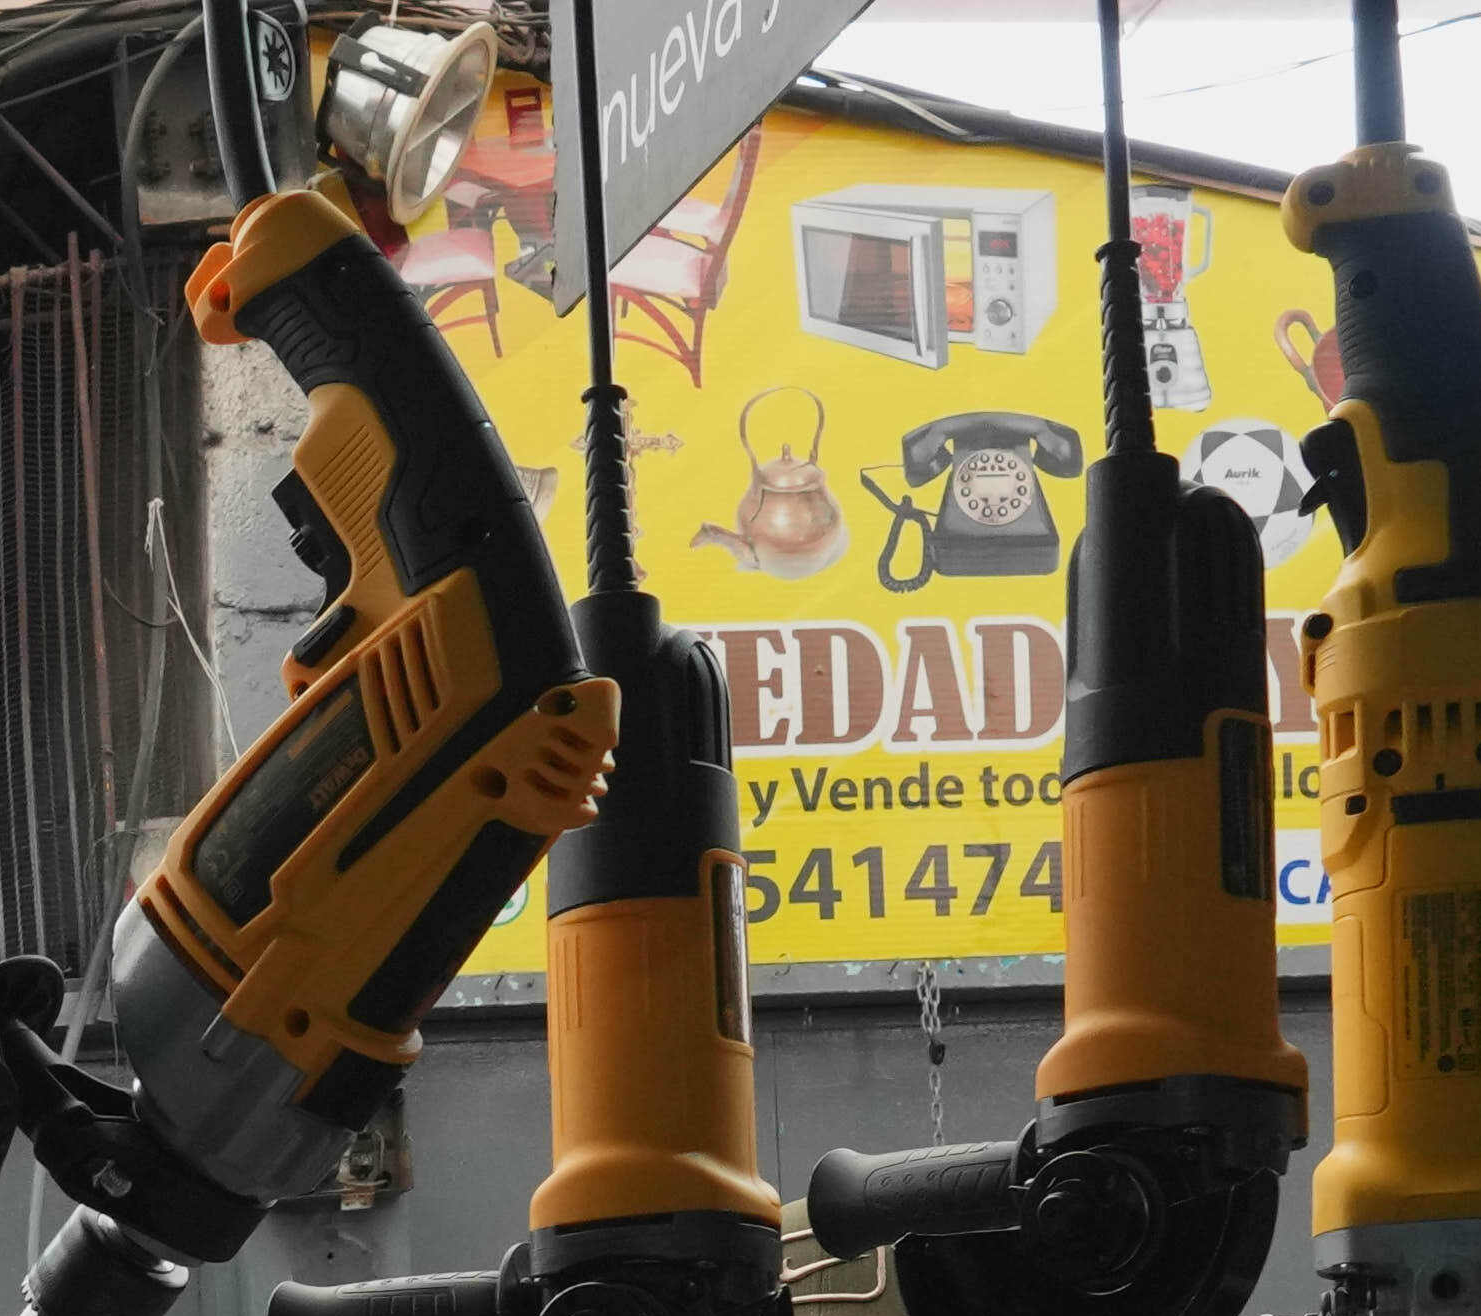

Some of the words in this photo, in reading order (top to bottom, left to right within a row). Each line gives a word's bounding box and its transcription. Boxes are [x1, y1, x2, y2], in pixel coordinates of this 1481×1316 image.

[603, 0, 742, 185] nueva
[748, 778, 779, 827] y
[791, 762, 964, 812] Vende
